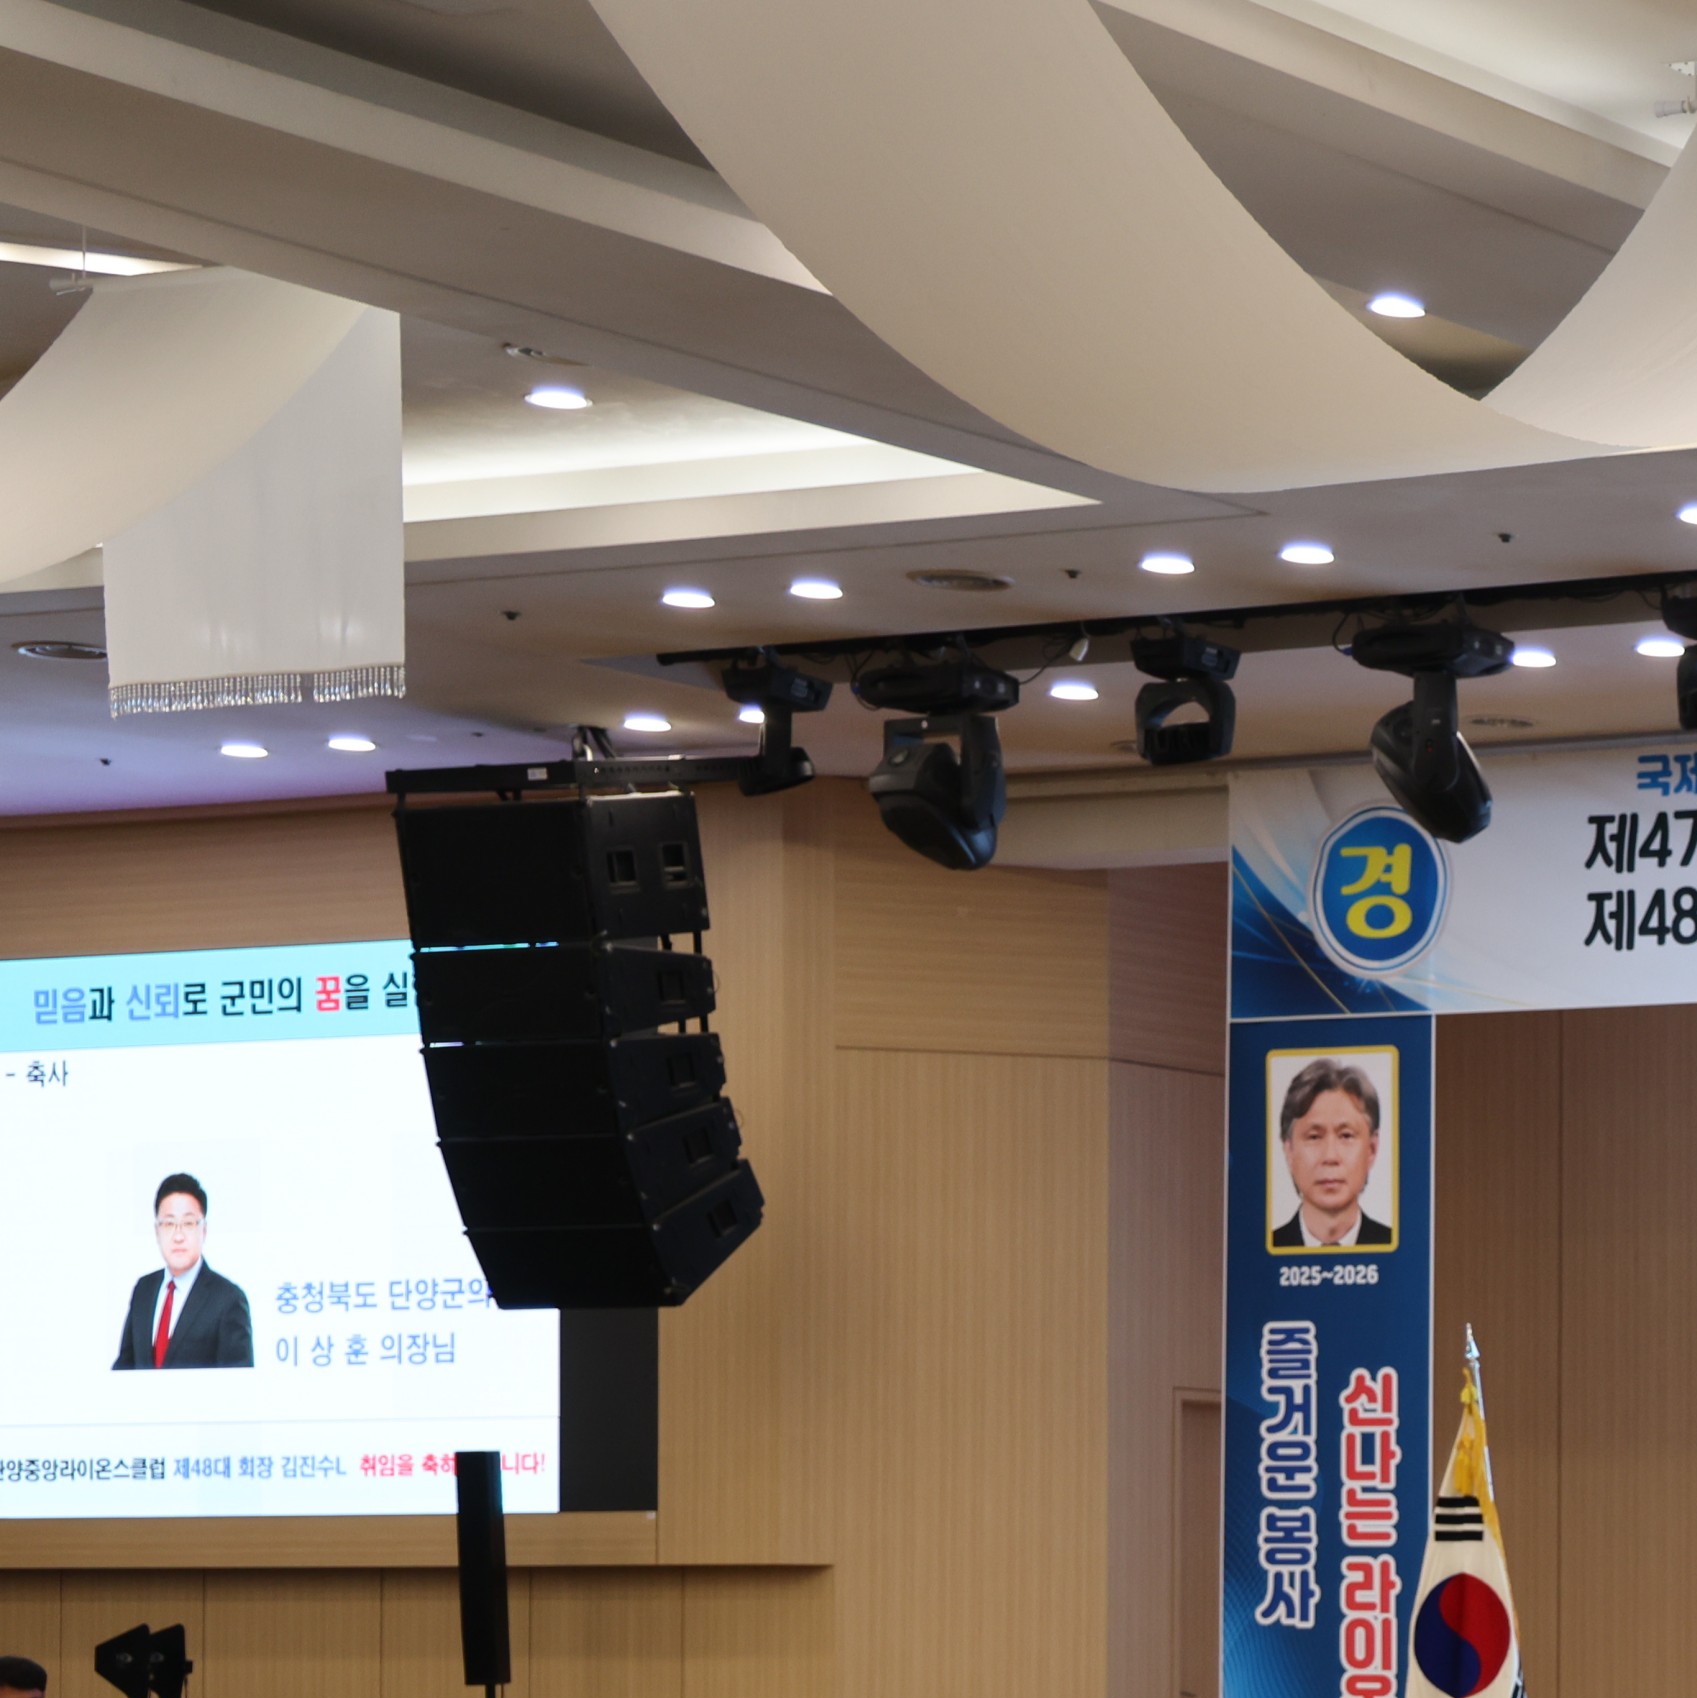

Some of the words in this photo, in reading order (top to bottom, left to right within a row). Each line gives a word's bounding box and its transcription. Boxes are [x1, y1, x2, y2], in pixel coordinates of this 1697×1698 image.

[1339, 843, 1413, 939] 경
[34, 986, 115, 1025] 믿음과
[127, 982, 208, 1021] 신뢰로
[220, 976, 303, 1017] 군민의
[315, 973, 370, 1013] 꿈을
[26, 1060, 69, 1088] 축사
[1278, 1264, 1379, 1286] 2025~2026
[276, 1280, 378, 1314] 충청북도
[379, 1332, 457, 1366] 의장님
[1261, 1322, 1317, 1499] 즐거운
[173, 1455, 231, 1480] 제48대
[238, 1455, 274, 1479] 회장
[360, 1452, 414, 1477] 취임을
[1340, 1367, 1401, 1546] 신나는
[1257, 1507, 1320, 1629] 봉사
